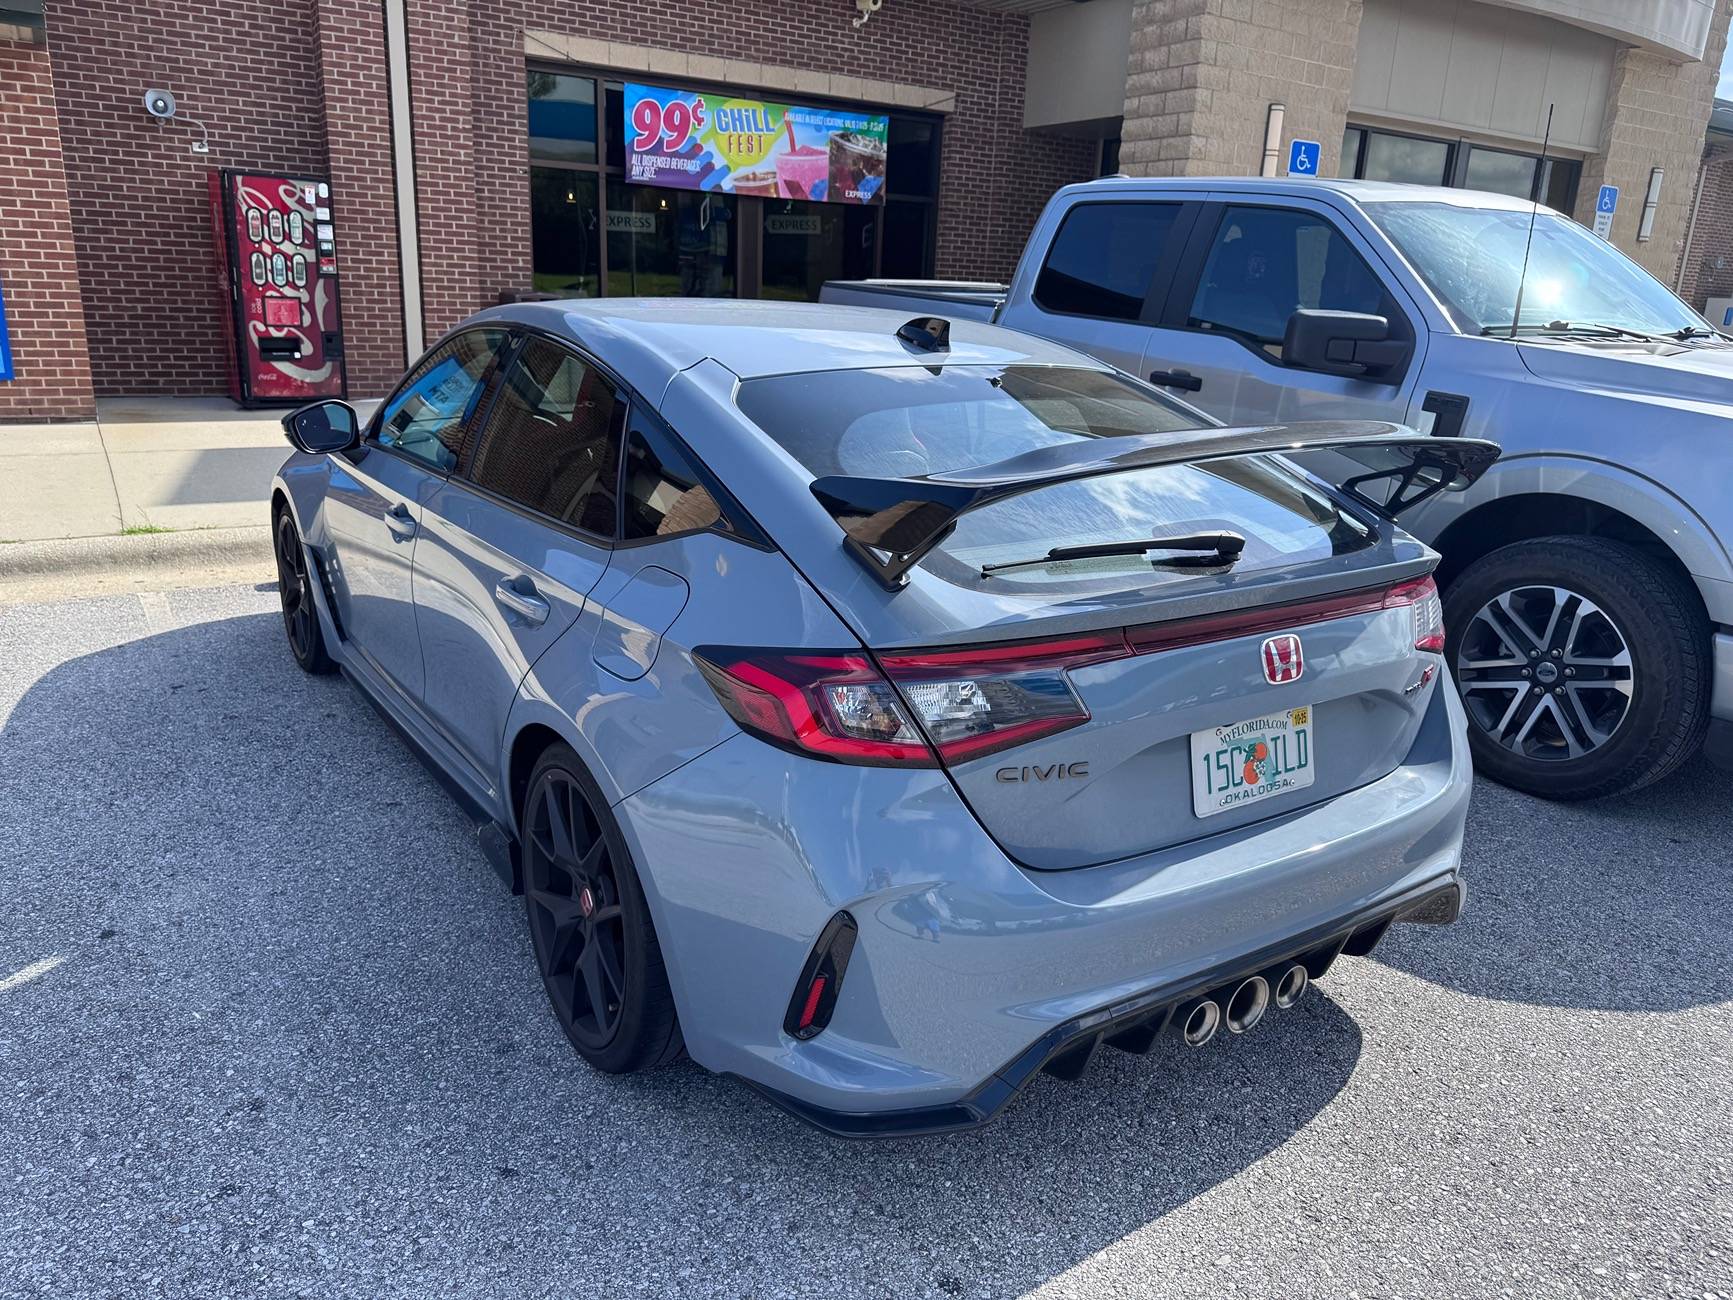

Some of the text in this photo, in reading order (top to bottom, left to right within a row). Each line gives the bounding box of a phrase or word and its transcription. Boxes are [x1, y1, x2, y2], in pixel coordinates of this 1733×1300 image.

[632, 97, 705, 152] 99¢
[728, 134, 763, 155] FEST
[631, 153, 641, 166] ALL
[642, 155, 671, 169] DISPENSED
[631, 165, 643, 177] ANY
[845, 189, 873, 200] EXPRESS
[607, 214, 652, 228] XPRESS
[771, 219, 817, 231] EXPRESS
[995, 761, 1089, 783] CIVIC
[1225, 778, 1289, 804] OKALOOSA
